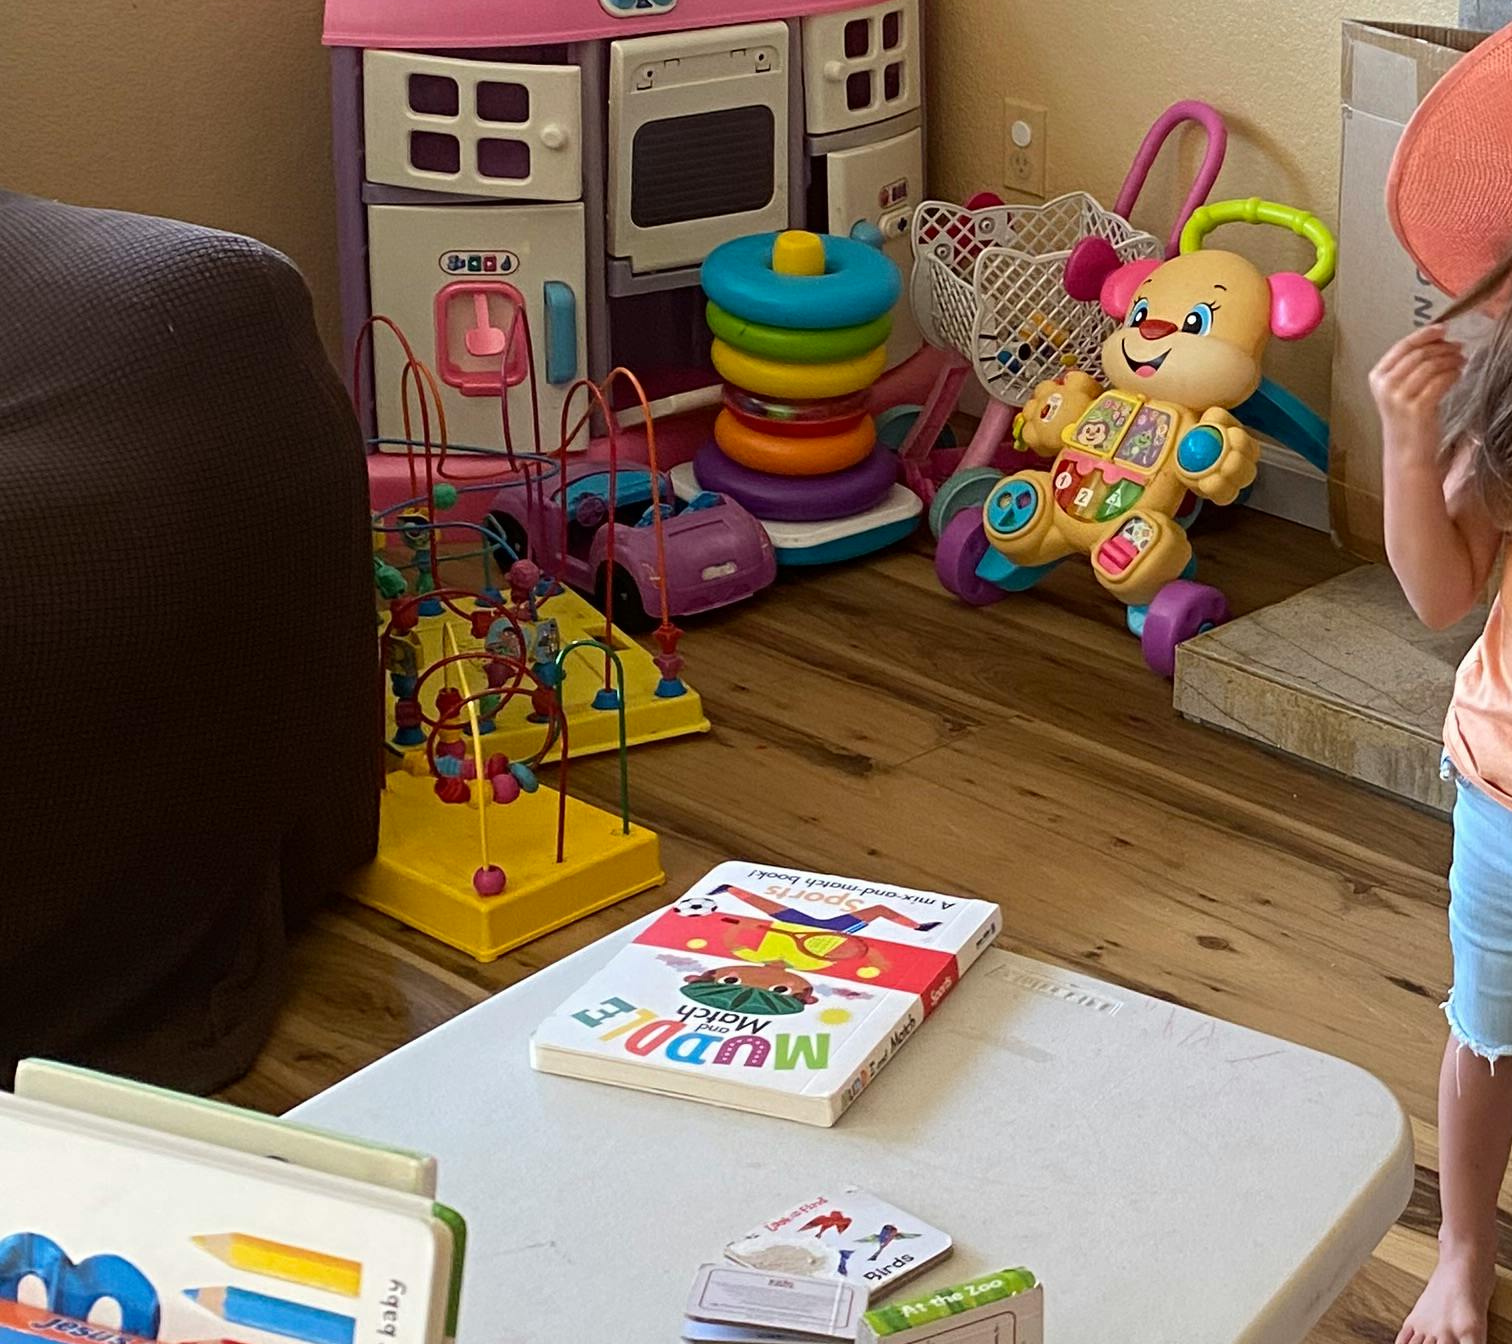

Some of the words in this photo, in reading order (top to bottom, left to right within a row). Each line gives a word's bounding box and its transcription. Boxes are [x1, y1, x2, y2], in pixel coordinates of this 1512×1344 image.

[1060, 474, 1067, 487] 1
[1078, 490, 1088, 503] 2
[747, 868, 803, 885] book!
[766, 884, 870, 913] Sports
[806, 875, 938, 907] mix-and-match
[939, 901, 957, 912] A
[571, 996, 831, 1071] MUDDLE
[677, 1003, 772, 1036] Match
[699, 1022, 731, 1035] and
[799, 1196, 829, 1213] Find
[863, 1253, 915, 1281] Birds
[376, 1279, 407, 1337] baby
[901, 1302, 929, 1319] At
[929, 1291, 965, 1307] the
[964, 1279, 1004, 1297] Zoo
